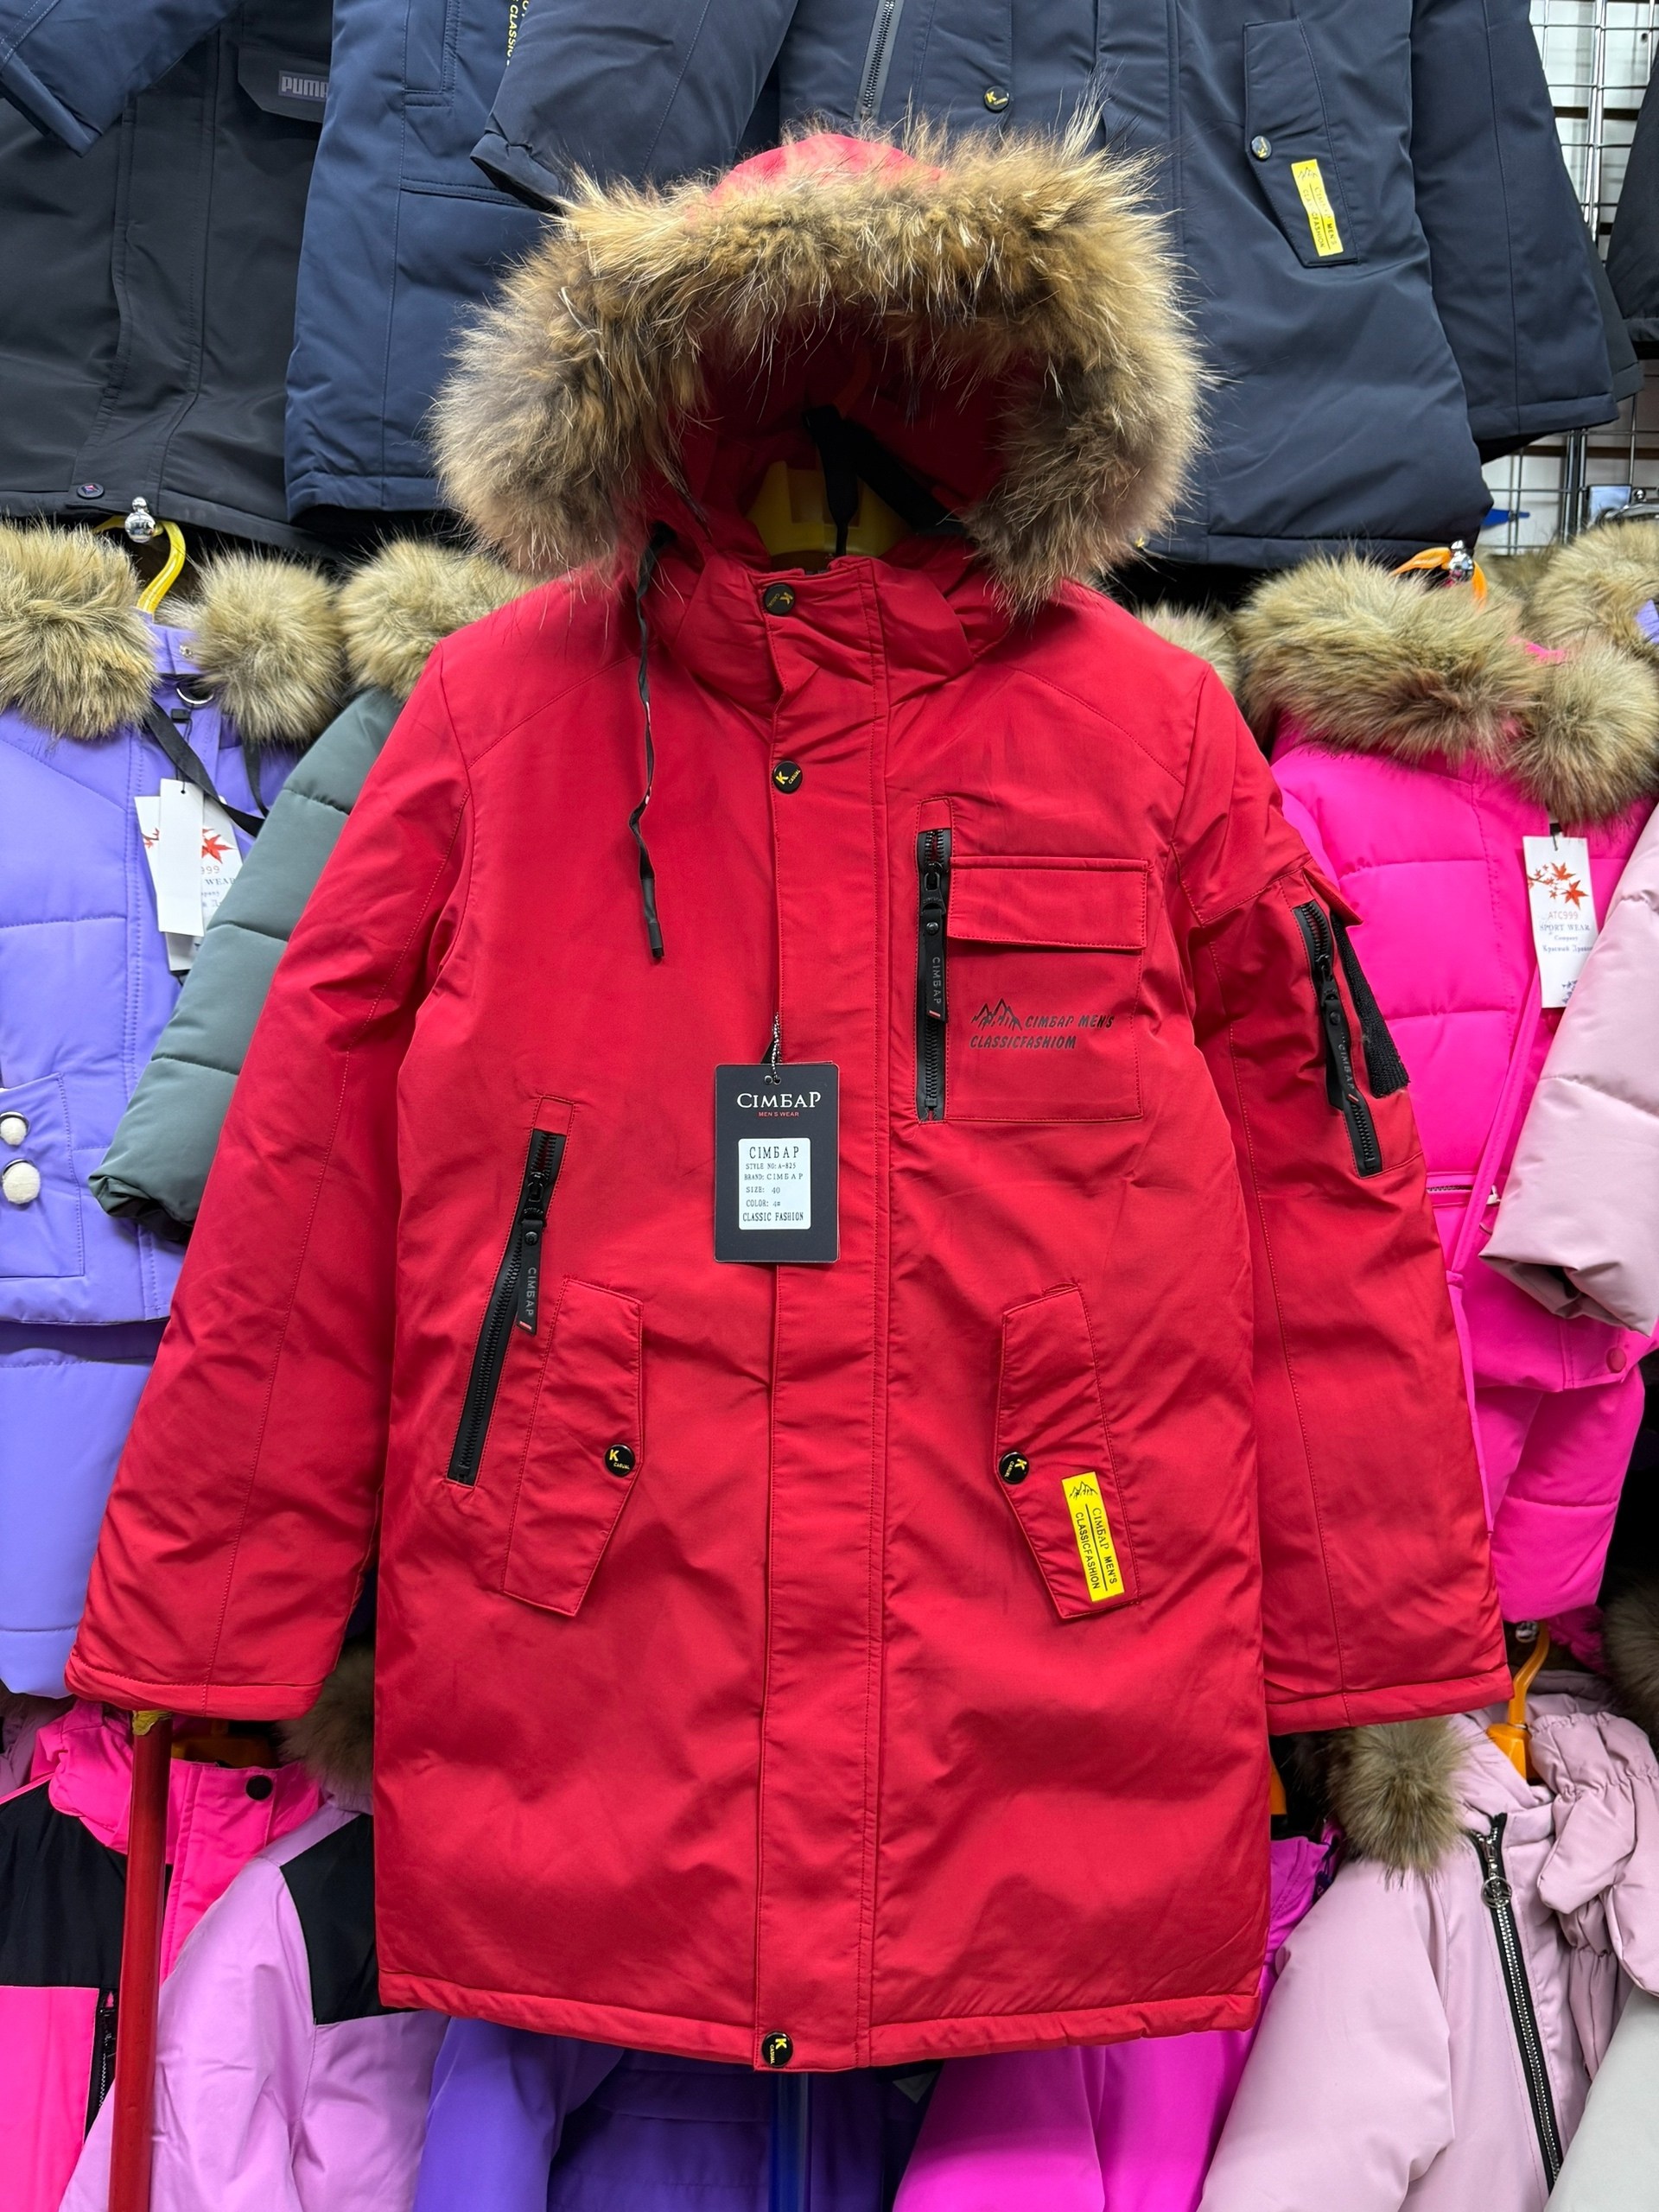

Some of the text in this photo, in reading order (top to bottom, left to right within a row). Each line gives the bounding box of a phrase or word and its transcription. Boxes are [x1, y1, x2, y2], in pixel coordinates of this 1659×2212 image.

[775, 771, 789, 785] K
[1078, 1014, 1115, 1028] MEN'S
[743, 1211, 804, 1222] CLASSIC FASHION
[609, 1449, 620, 1461] K
[1014, 1459, 1027, 1471] K
[1075, 1512, 1101, 1589] CLASSICFASHION
[1104, 1555, 1117, 1584] MEN'S
[775, 2038, 787, 2050] K
